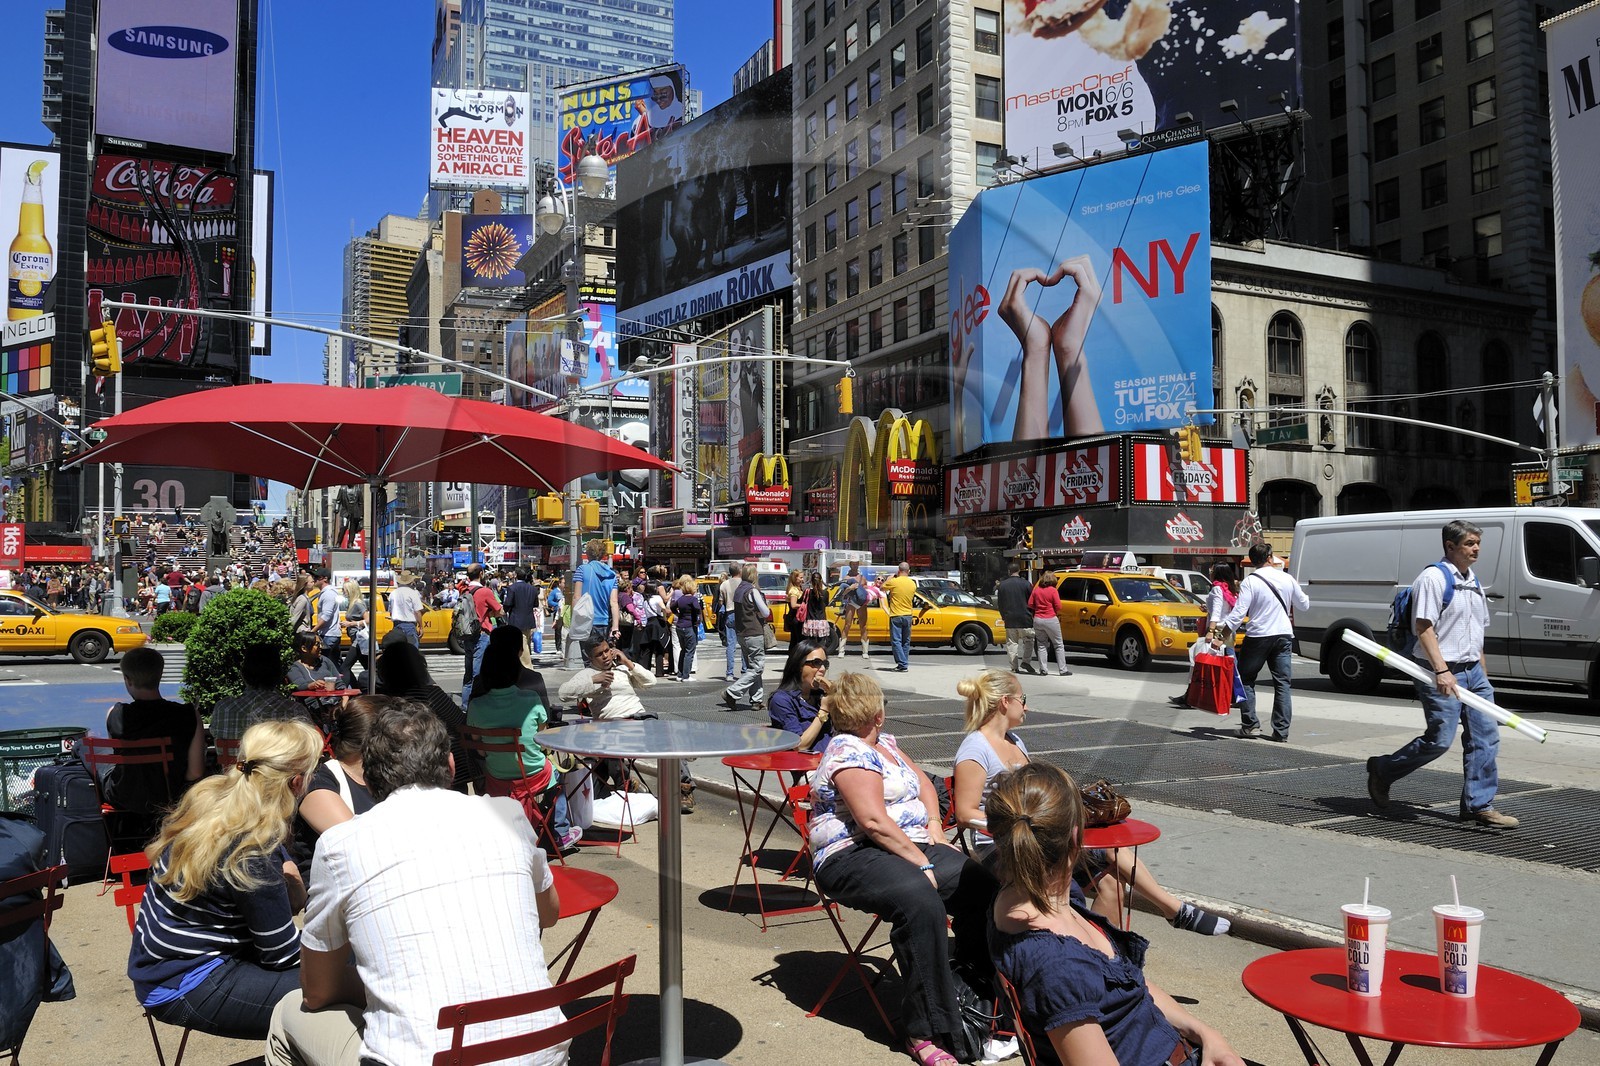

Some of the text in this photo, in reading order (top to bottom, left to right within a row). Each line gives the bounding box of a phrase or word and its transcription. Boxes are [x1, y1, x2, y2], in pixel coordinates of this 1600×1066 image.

[125, 28, 213, 56] SAMSUNG
[1006, 66, 1133, 112] MasterChef
[1057, 81, 1134, 116] MON 6/6
[1057, 99, 1133, 132] 8PM FOX 5
[108, 137, 143, 148] SHERWOOD
[1164, 131, 1201, 143] SPECTACOLOR
[437, 143, 455, 153] ON
[437, 153, 523, 164] SOMETHING LIKE
[437, 161, 450, 174] A
[105, 160, 215, 203] Coca-Cola
[1081, 203, 1104, 216] Start
[1105, 193, 1154, 212] spreading
[1157, 189, 1174, 200] the
[12, 252, 49, 264] Corona
[1112, 231, 1201, 304] NY
[620, 262, 775, 341] REAL HUSTLAZ DRINK RÖKK
[3, 316, 55, 340] INGLOT
[566, 342, 586, 352] NYPD
[1114, 371, 1198, 389] SEASON FINALE
[1114, 381, 1197, 407] TUE 5/24
[1114, 400, 1198, 425] 9PM FOX 5
[1270, 431, 1276, 441] 7
[890, 465, 939, 475] McDonald's
[133, 479, 185, 513] 30
[446, 493, 464, 501] WITH
[748, 489, 790, 498] McDonald's
[4, 526, 17, 556] tkts
[911, 615, 935, 627] TAXI
[1089, 614, 1108, 627] TAXI
[15, 624, 45, 635] TAXI
[1543, 624, 1571, 632] STAMFORD
[21, 743, 34, 751] York
[34, 742, 45, 750] City
[1347, 938, 1361, 950] GOOD
[1443, 940, 1459, 953] GOOD
[1347, 948, 1369, 965] COLD
[1443, 951, 1467, 967] COLD
